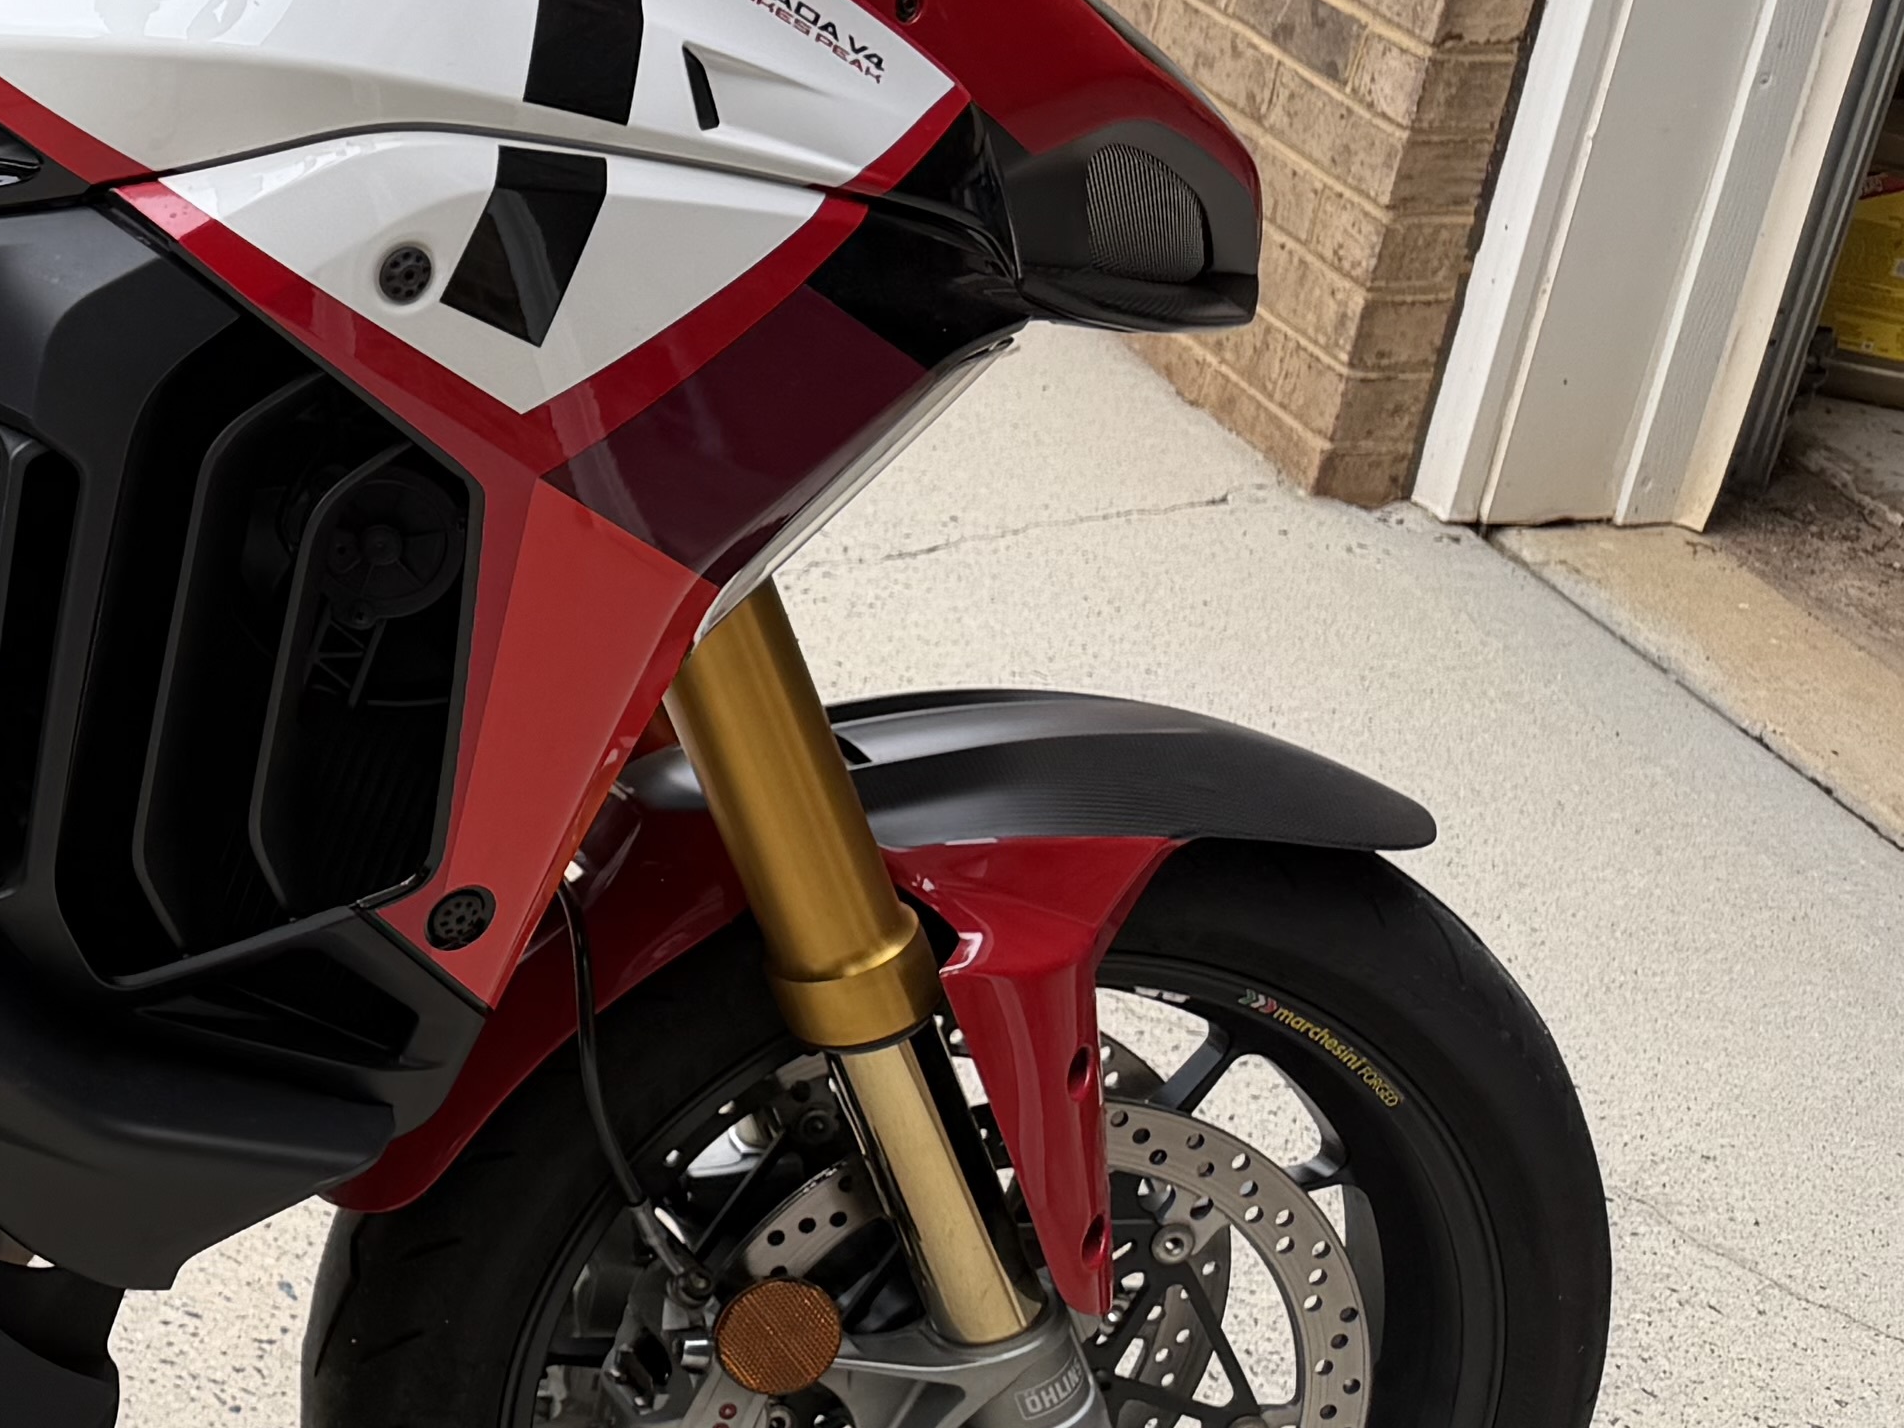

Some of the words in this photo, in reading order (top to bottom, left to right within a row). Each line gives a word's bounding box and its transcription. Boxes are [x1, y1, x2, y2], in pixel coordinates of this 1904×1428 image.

[815, 33, 882, 84] PEAK
[848, 34, 884, 71] V4
[1273, 1006, 1367, 1072] marchesini
[1359, 1065, 1401, 1109] FORGED
